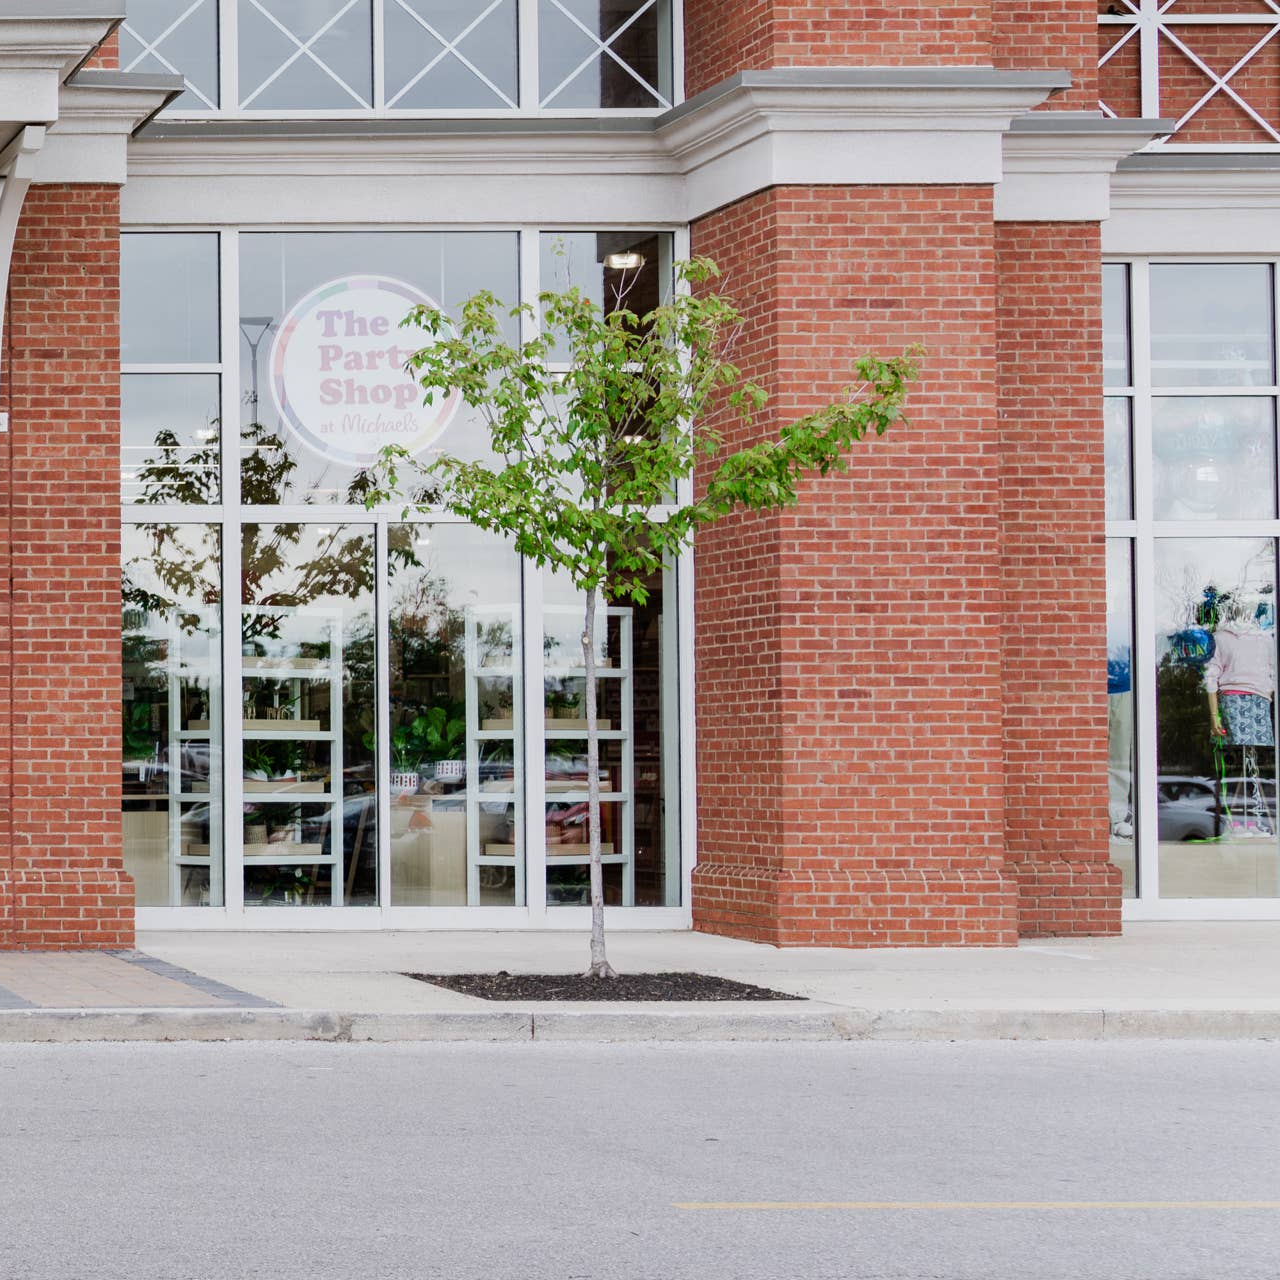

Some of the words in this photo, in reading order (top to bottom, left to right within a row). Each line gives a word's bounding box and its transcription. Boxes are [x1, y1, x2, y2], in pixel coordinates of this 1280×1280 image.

[316, 309, 390, 338] The
[319, 377, 419, 410] Shop
[320, 422, 336, 434] at
[341, 411, 419, 435] Michaels
